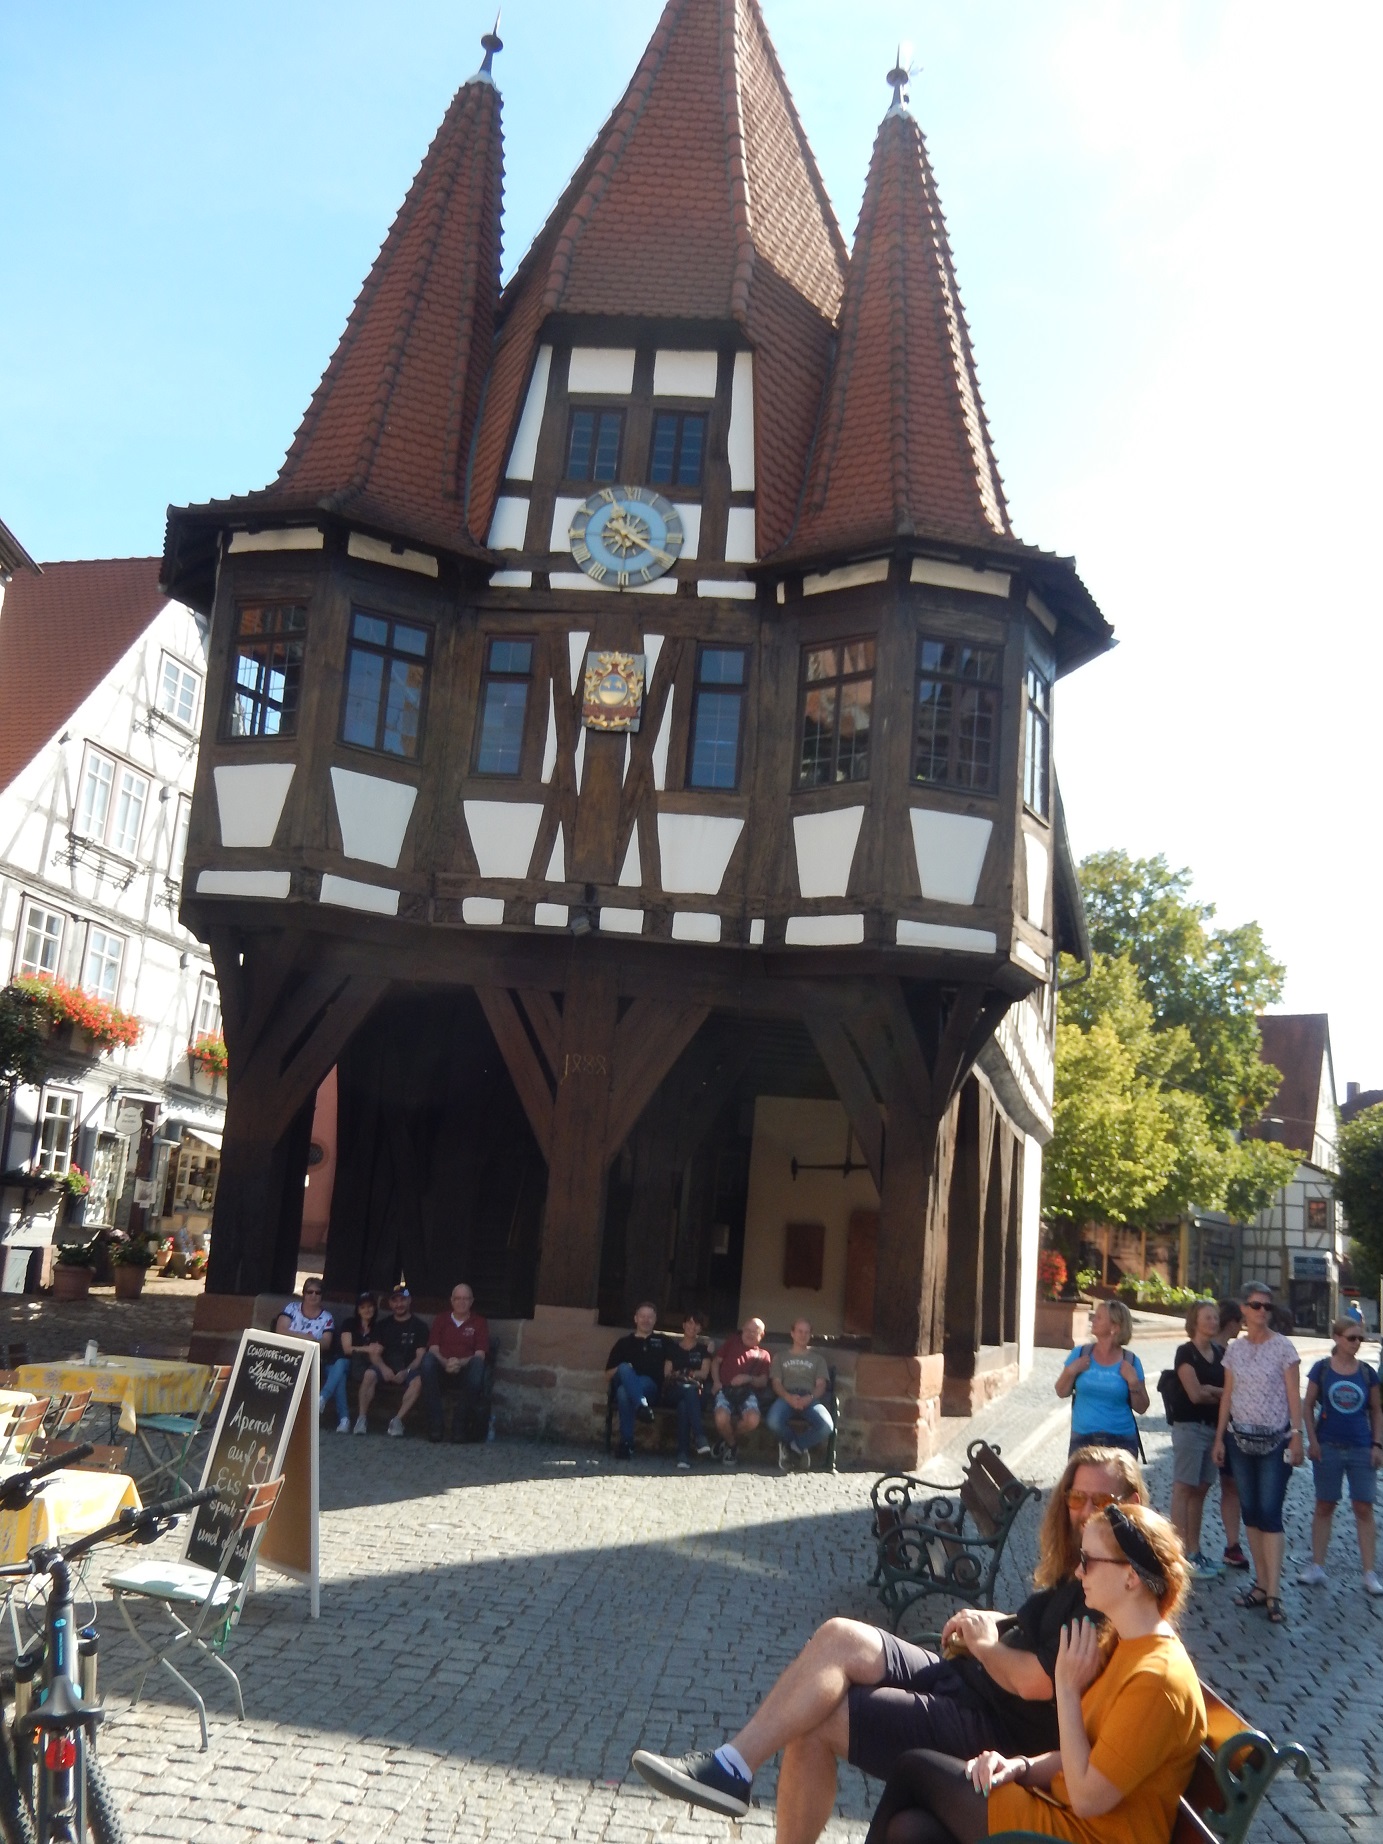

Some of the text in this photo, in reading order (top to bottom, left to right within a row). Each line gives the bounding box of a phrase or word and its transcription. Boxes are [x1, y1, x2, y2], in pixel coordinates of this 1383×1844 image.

[228, 1401, 275, 1441] Aperol
[227, 1440, 257, 1477] auf
[216, 1467, 242, 1495] Eis
[197, 1526, 220, 1546] und
